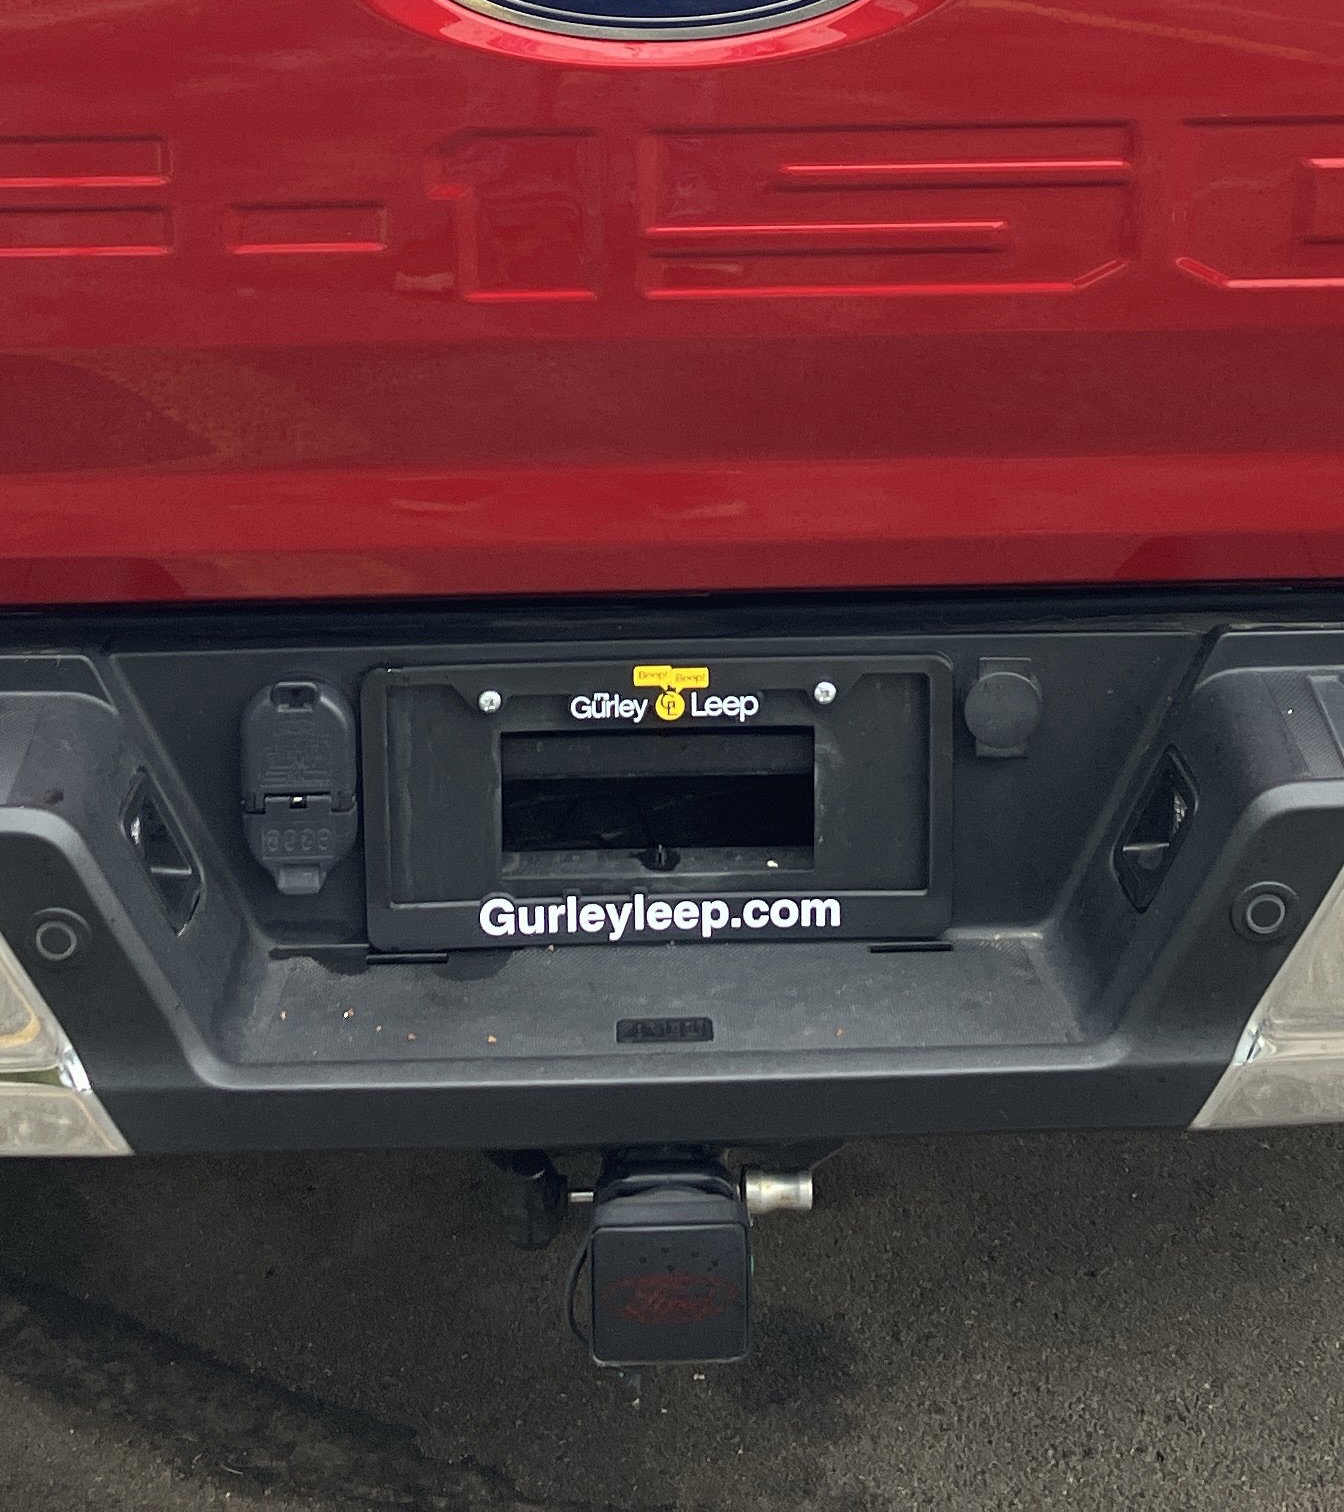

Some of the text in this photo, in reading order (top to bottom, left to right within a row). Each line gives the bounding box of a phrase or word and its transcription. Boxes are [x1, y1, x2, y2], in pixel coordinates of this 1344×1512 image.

[638, 669, 707, 684] Beep! Beep!
[570, 693, 649, 723] Gurley
[691, 691, 759, 722] Leep
[479, 893, 841, 941] Gurleyleep.com
